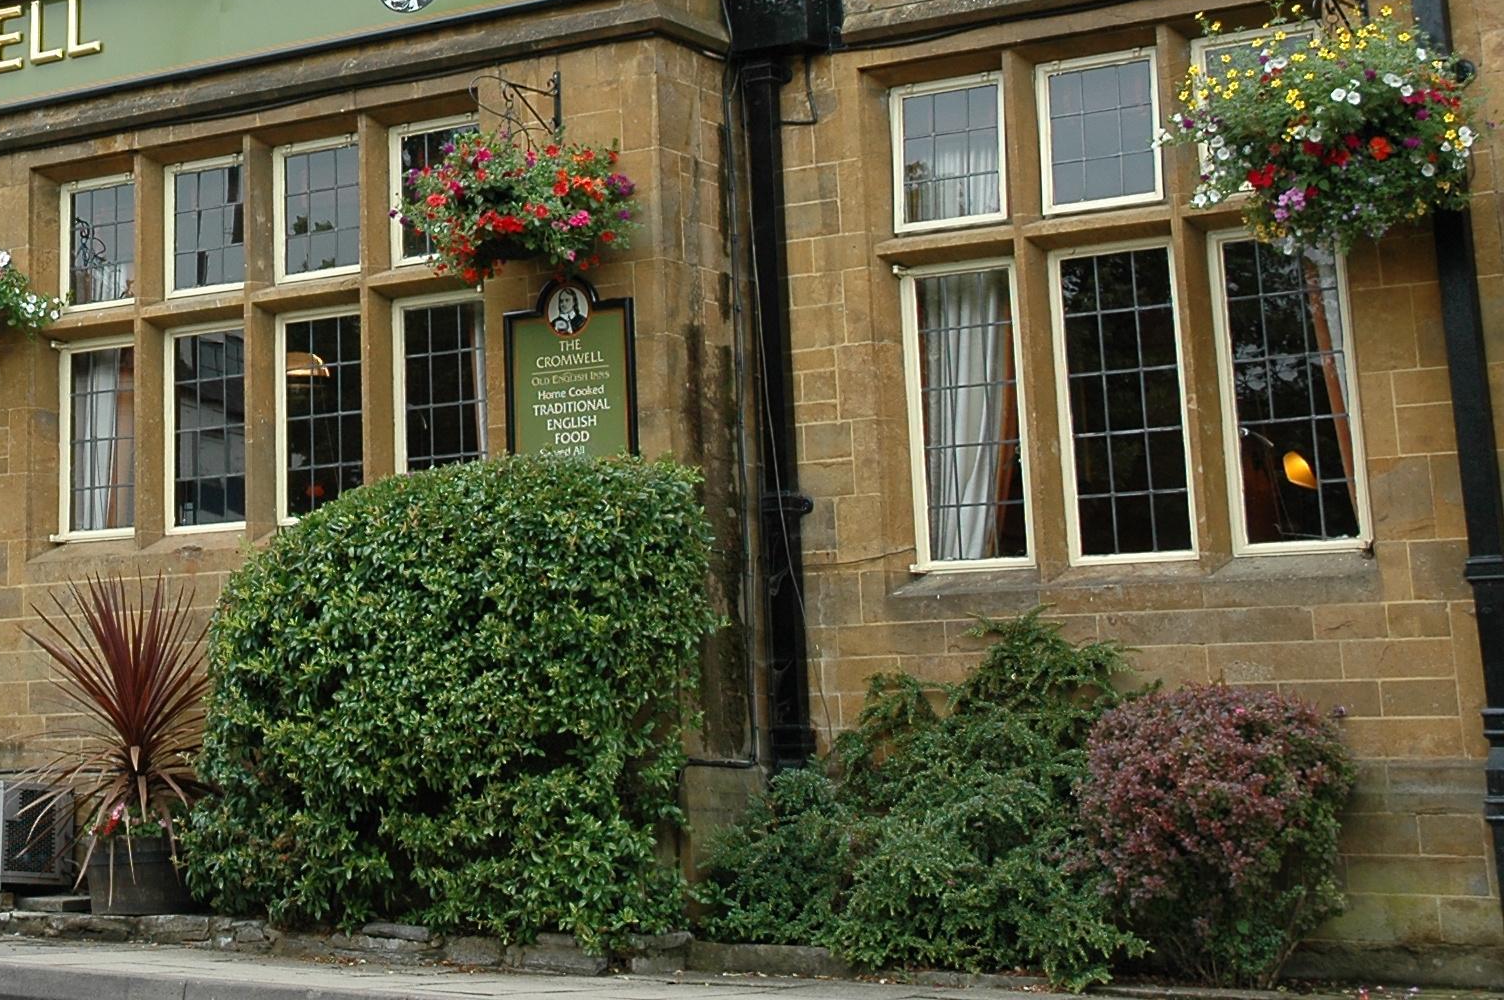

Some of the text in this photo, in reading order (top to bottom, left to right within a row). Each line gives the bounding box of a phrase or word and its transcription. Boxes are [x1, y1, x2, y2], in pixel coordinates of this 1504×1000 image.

[559, 339, 582, 352] THE
[536, 351, 604, 369] CROMWELL
[538, 384, 605, 401] Home Cooked
[532, 398, 611, 417] TRADITIONAL
[547, 415, 597, 431] ENGLISH
[555, 430, 590, 445] FOOD
